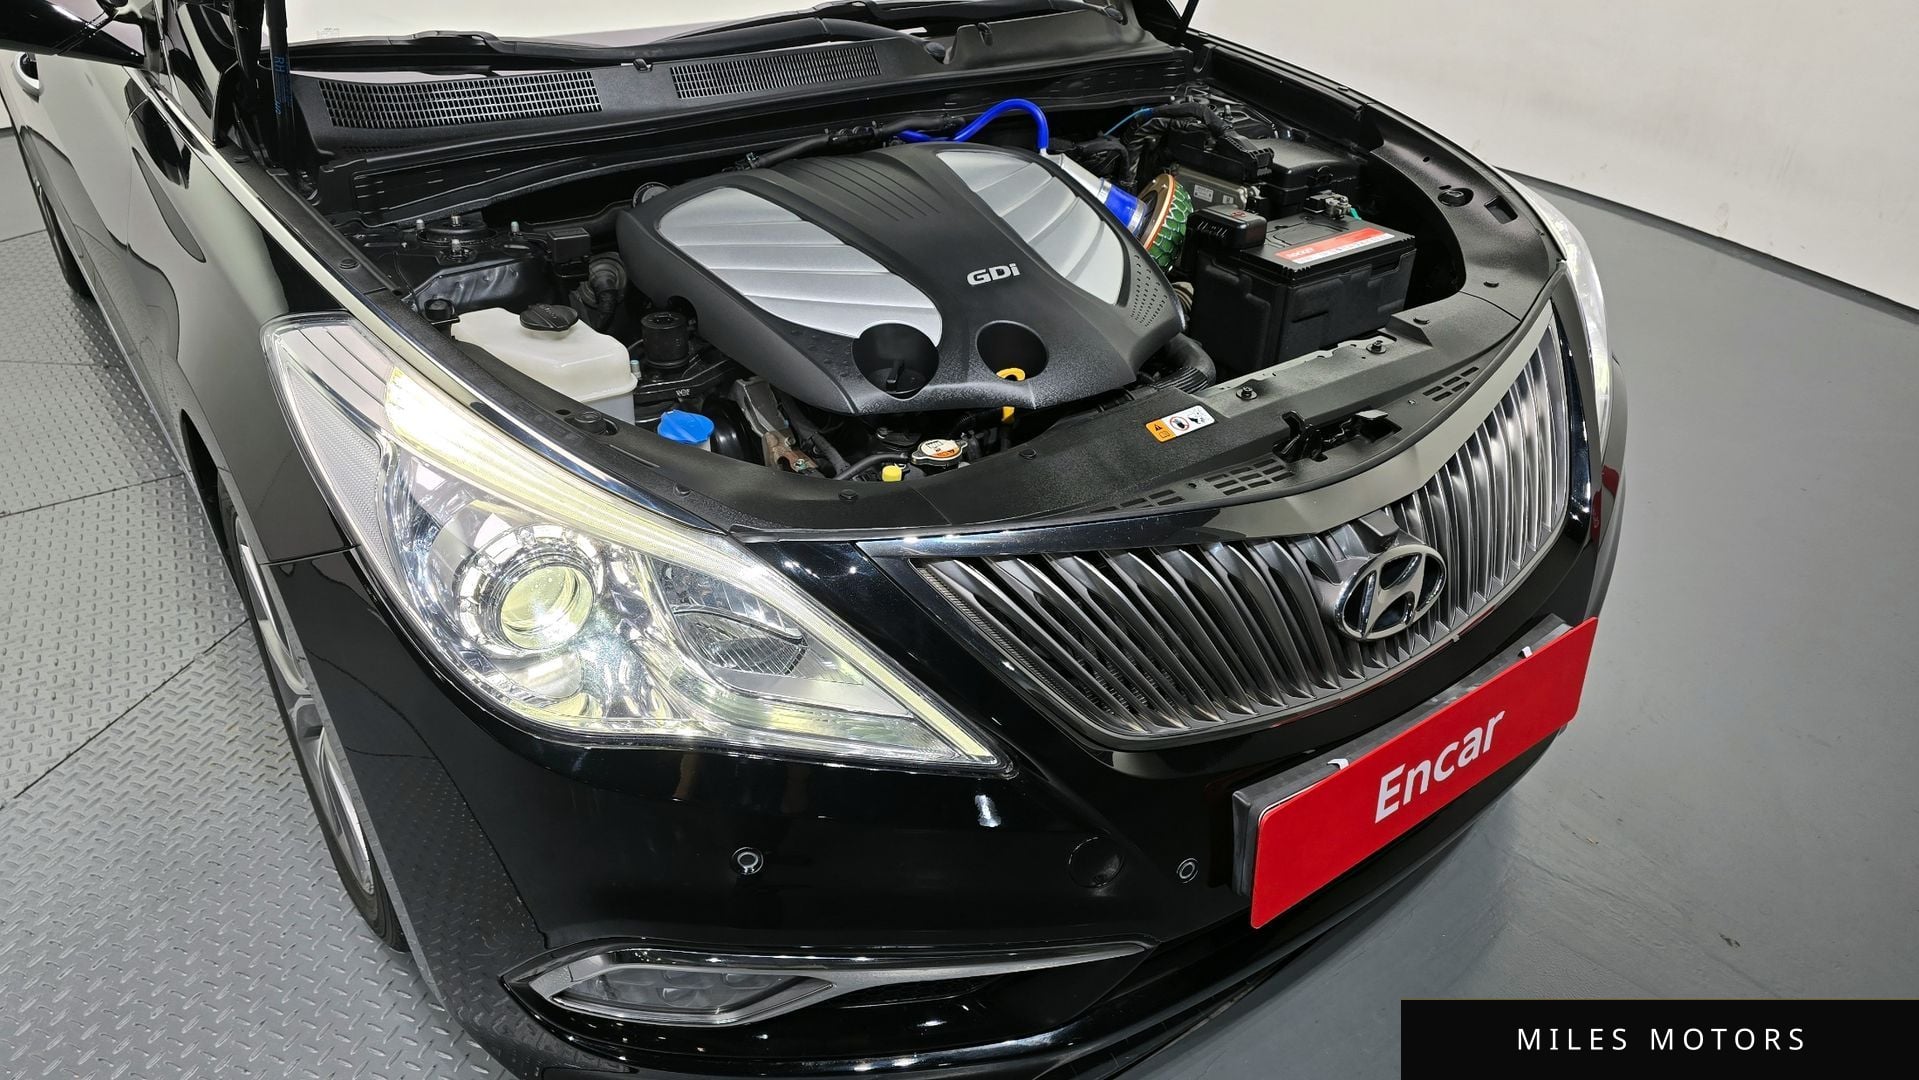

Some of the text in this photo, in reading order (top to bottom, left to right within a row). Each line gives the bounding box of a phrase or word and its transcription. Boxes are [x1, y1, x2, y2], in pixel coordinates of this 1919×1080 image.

[274, 56, 285, 72] RH
[967, 263, 1020, 285] GDi
[1375, 711, 1505, 824] Encar
